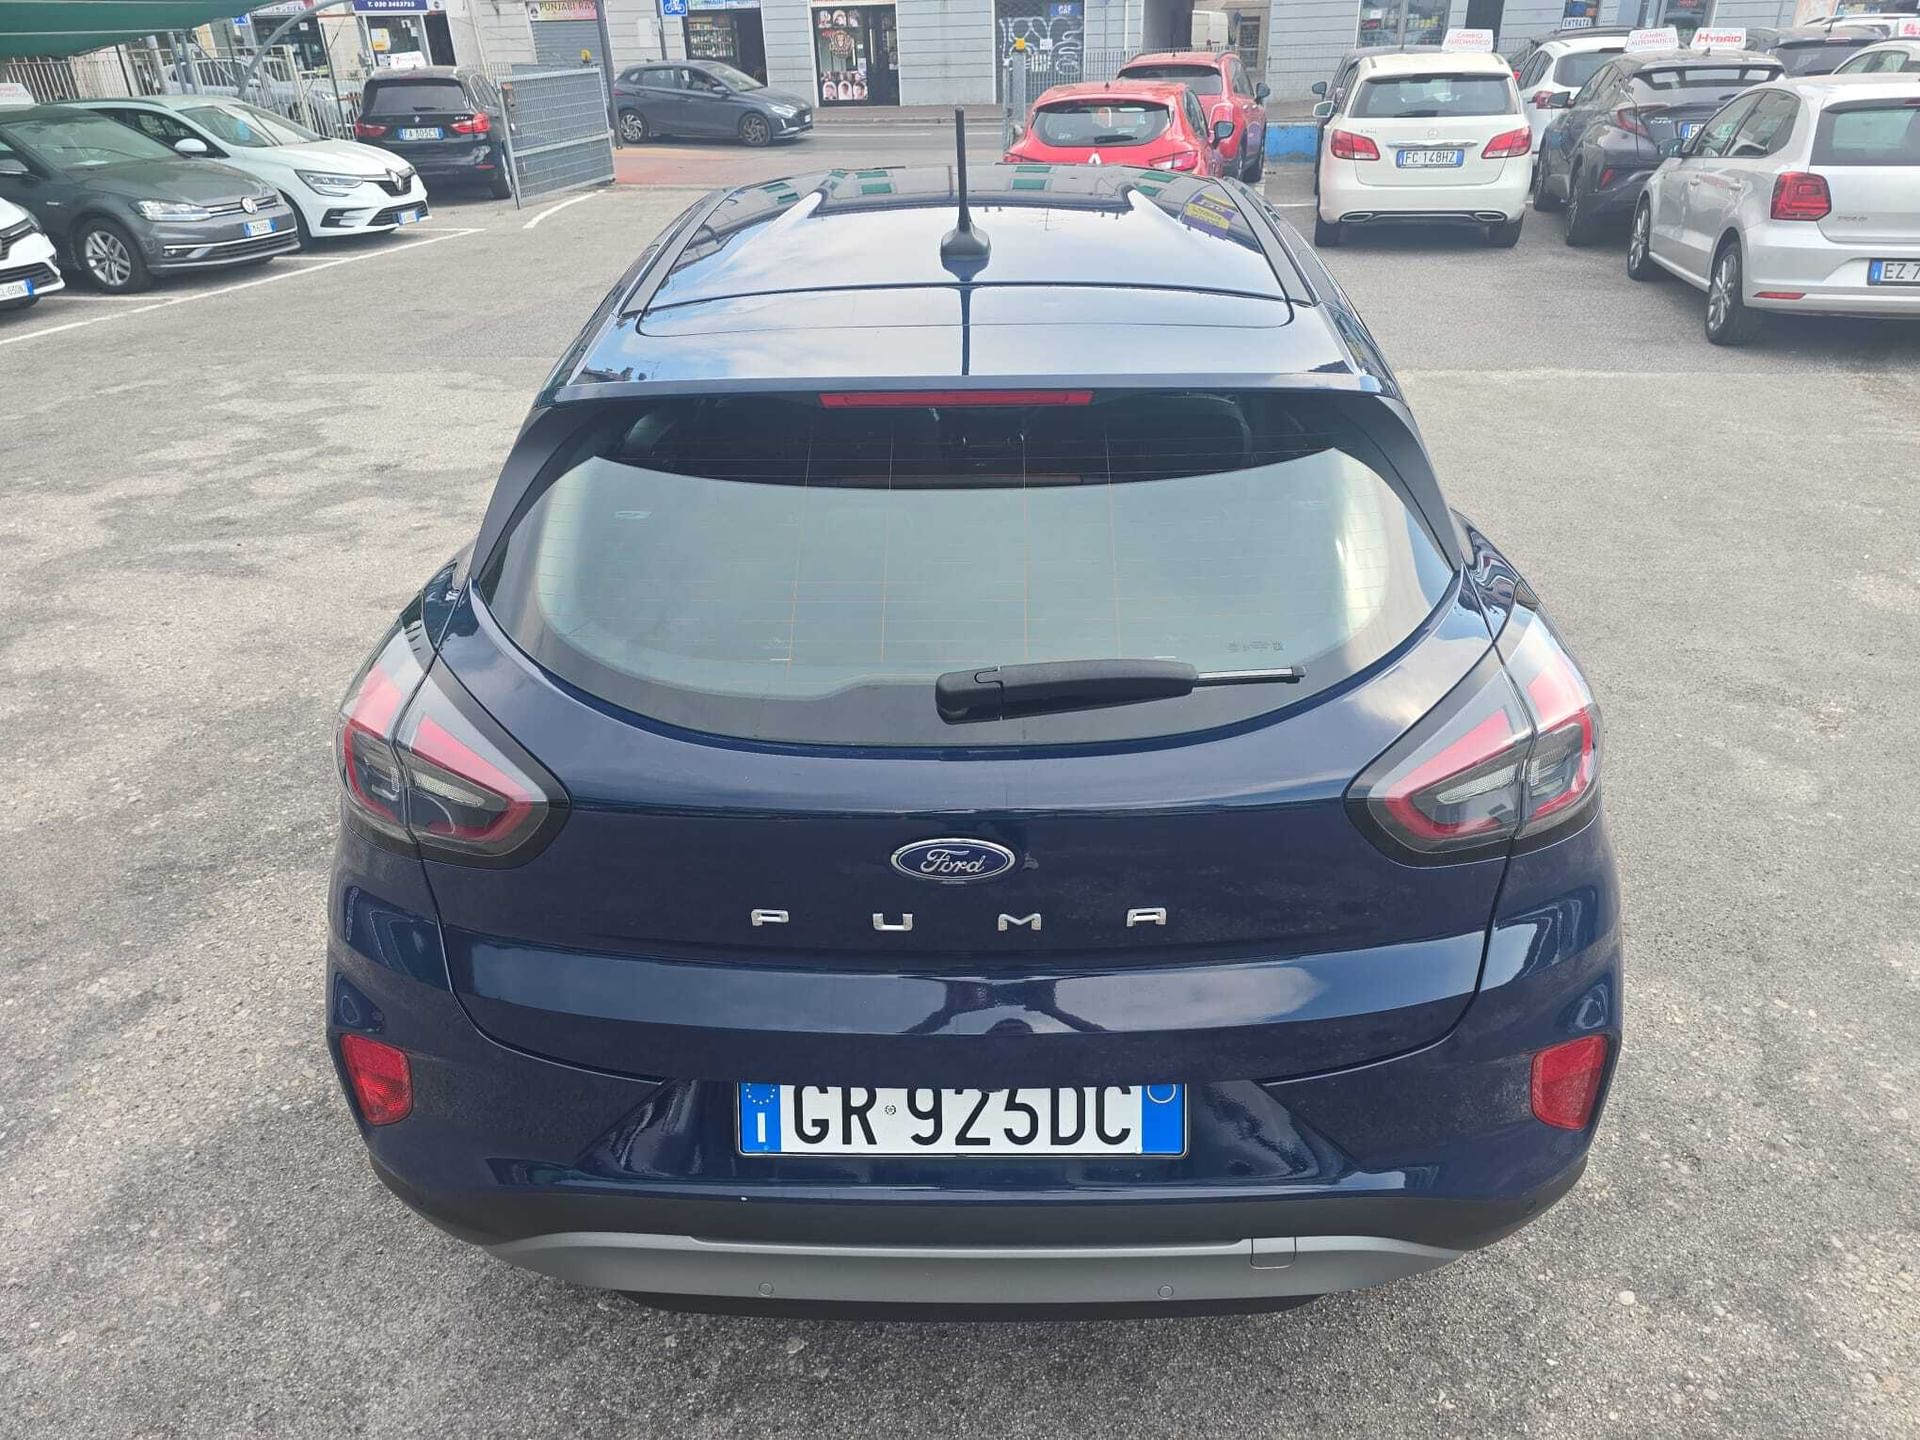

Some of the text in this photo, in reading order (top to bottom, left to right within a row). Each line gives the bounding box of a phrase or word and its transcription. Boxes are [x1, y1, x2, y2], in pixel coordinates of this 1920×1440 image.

[1697, 34, 1742, 44] HYBRID
[1405, 151, 1456, 163] FC 148HZ
[1884, 263, 1907, 279] EZ
[920, 849, 986, 876] Ford
[750, 907, 1167, 931] PUMA
[793, 1085, 877, 1145] GR
